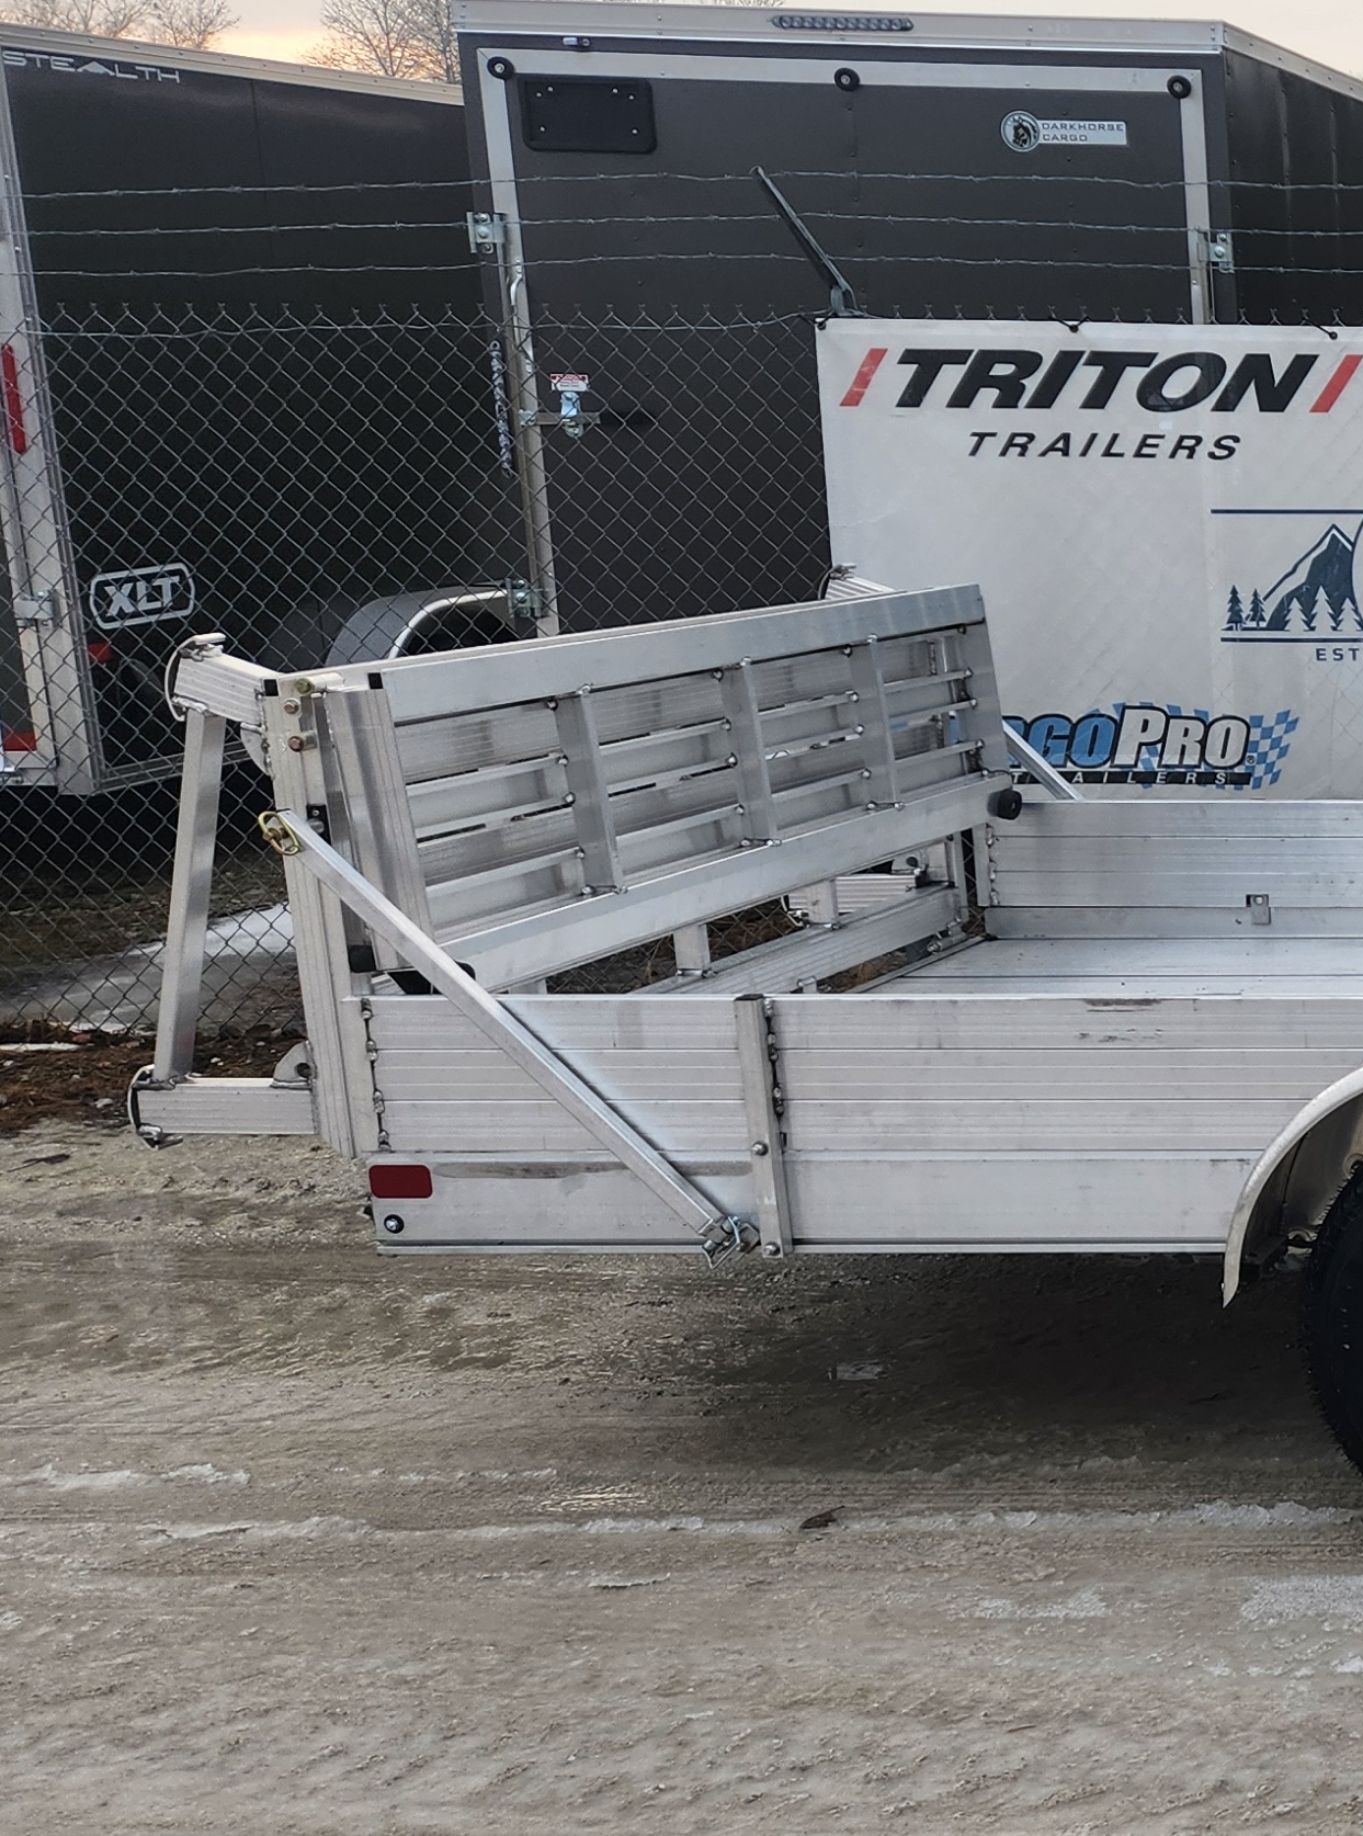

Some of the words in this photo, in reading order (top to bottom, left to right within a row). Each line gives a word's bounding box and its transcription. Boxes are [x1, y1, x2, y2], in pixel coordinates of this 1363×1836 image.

[1042, 122, 1124, 132] DARKHORSE
[1042, 133, 1088, 142] CARGO
[895, 348, 1319, 413] TRITON
[967, 431, 1242, 460] TRAILERS
[104, 576, 180, 617] XLT
[1012, 772, 1227, 785] TAILERS
